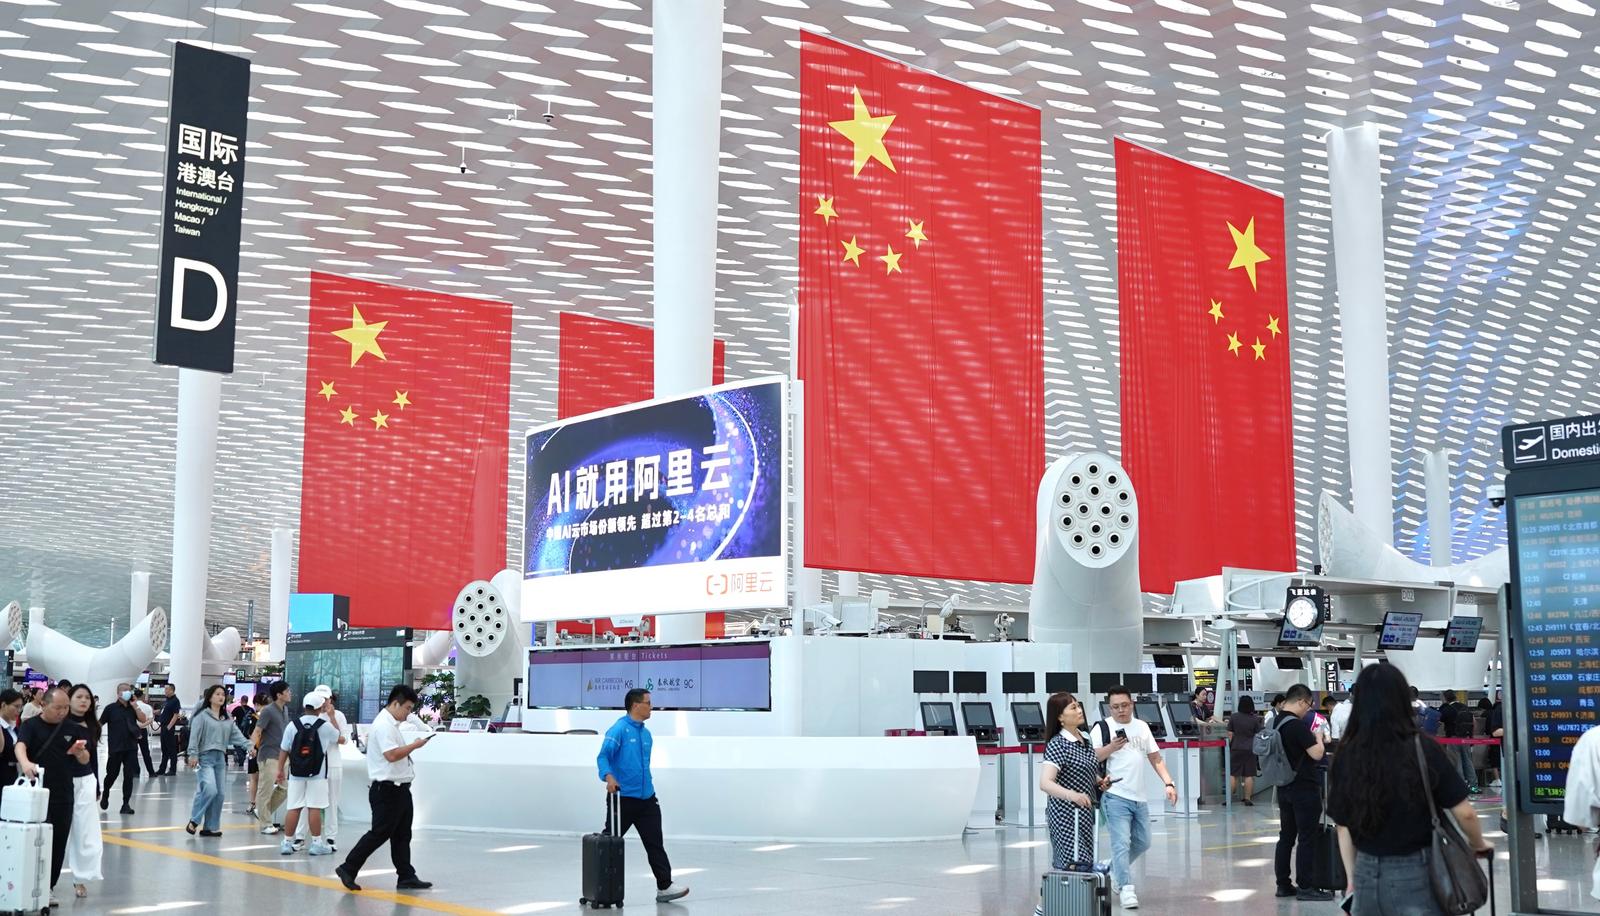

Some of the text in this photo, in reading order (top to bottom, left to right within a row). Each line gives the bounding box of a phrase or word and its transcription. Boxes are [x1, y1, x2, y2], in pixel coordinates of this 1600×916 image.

[177, 123, 239, 165] 国际
[176, 161, 235, 192] 港澳台
[175, 186, 223, 204] International
[174, 200, 214, 216] Hongkong
[174, 211, 201, 225] Macao
[173, 223, 201, 237] Taiwan
[170, 256, 228, 332] D
[1550, 419, 1600, 441] 国内出
[1552, 443, 1600, 460] Domesti
[546, 441, 731, 516] AI就用阿里云
[731, 571, 773, 594] 阿里云
[683, 678, 695, 689] 9C
[1535, 749, 1551, 757] 13:00
[1536, 774, 1552, 782] 13:00
